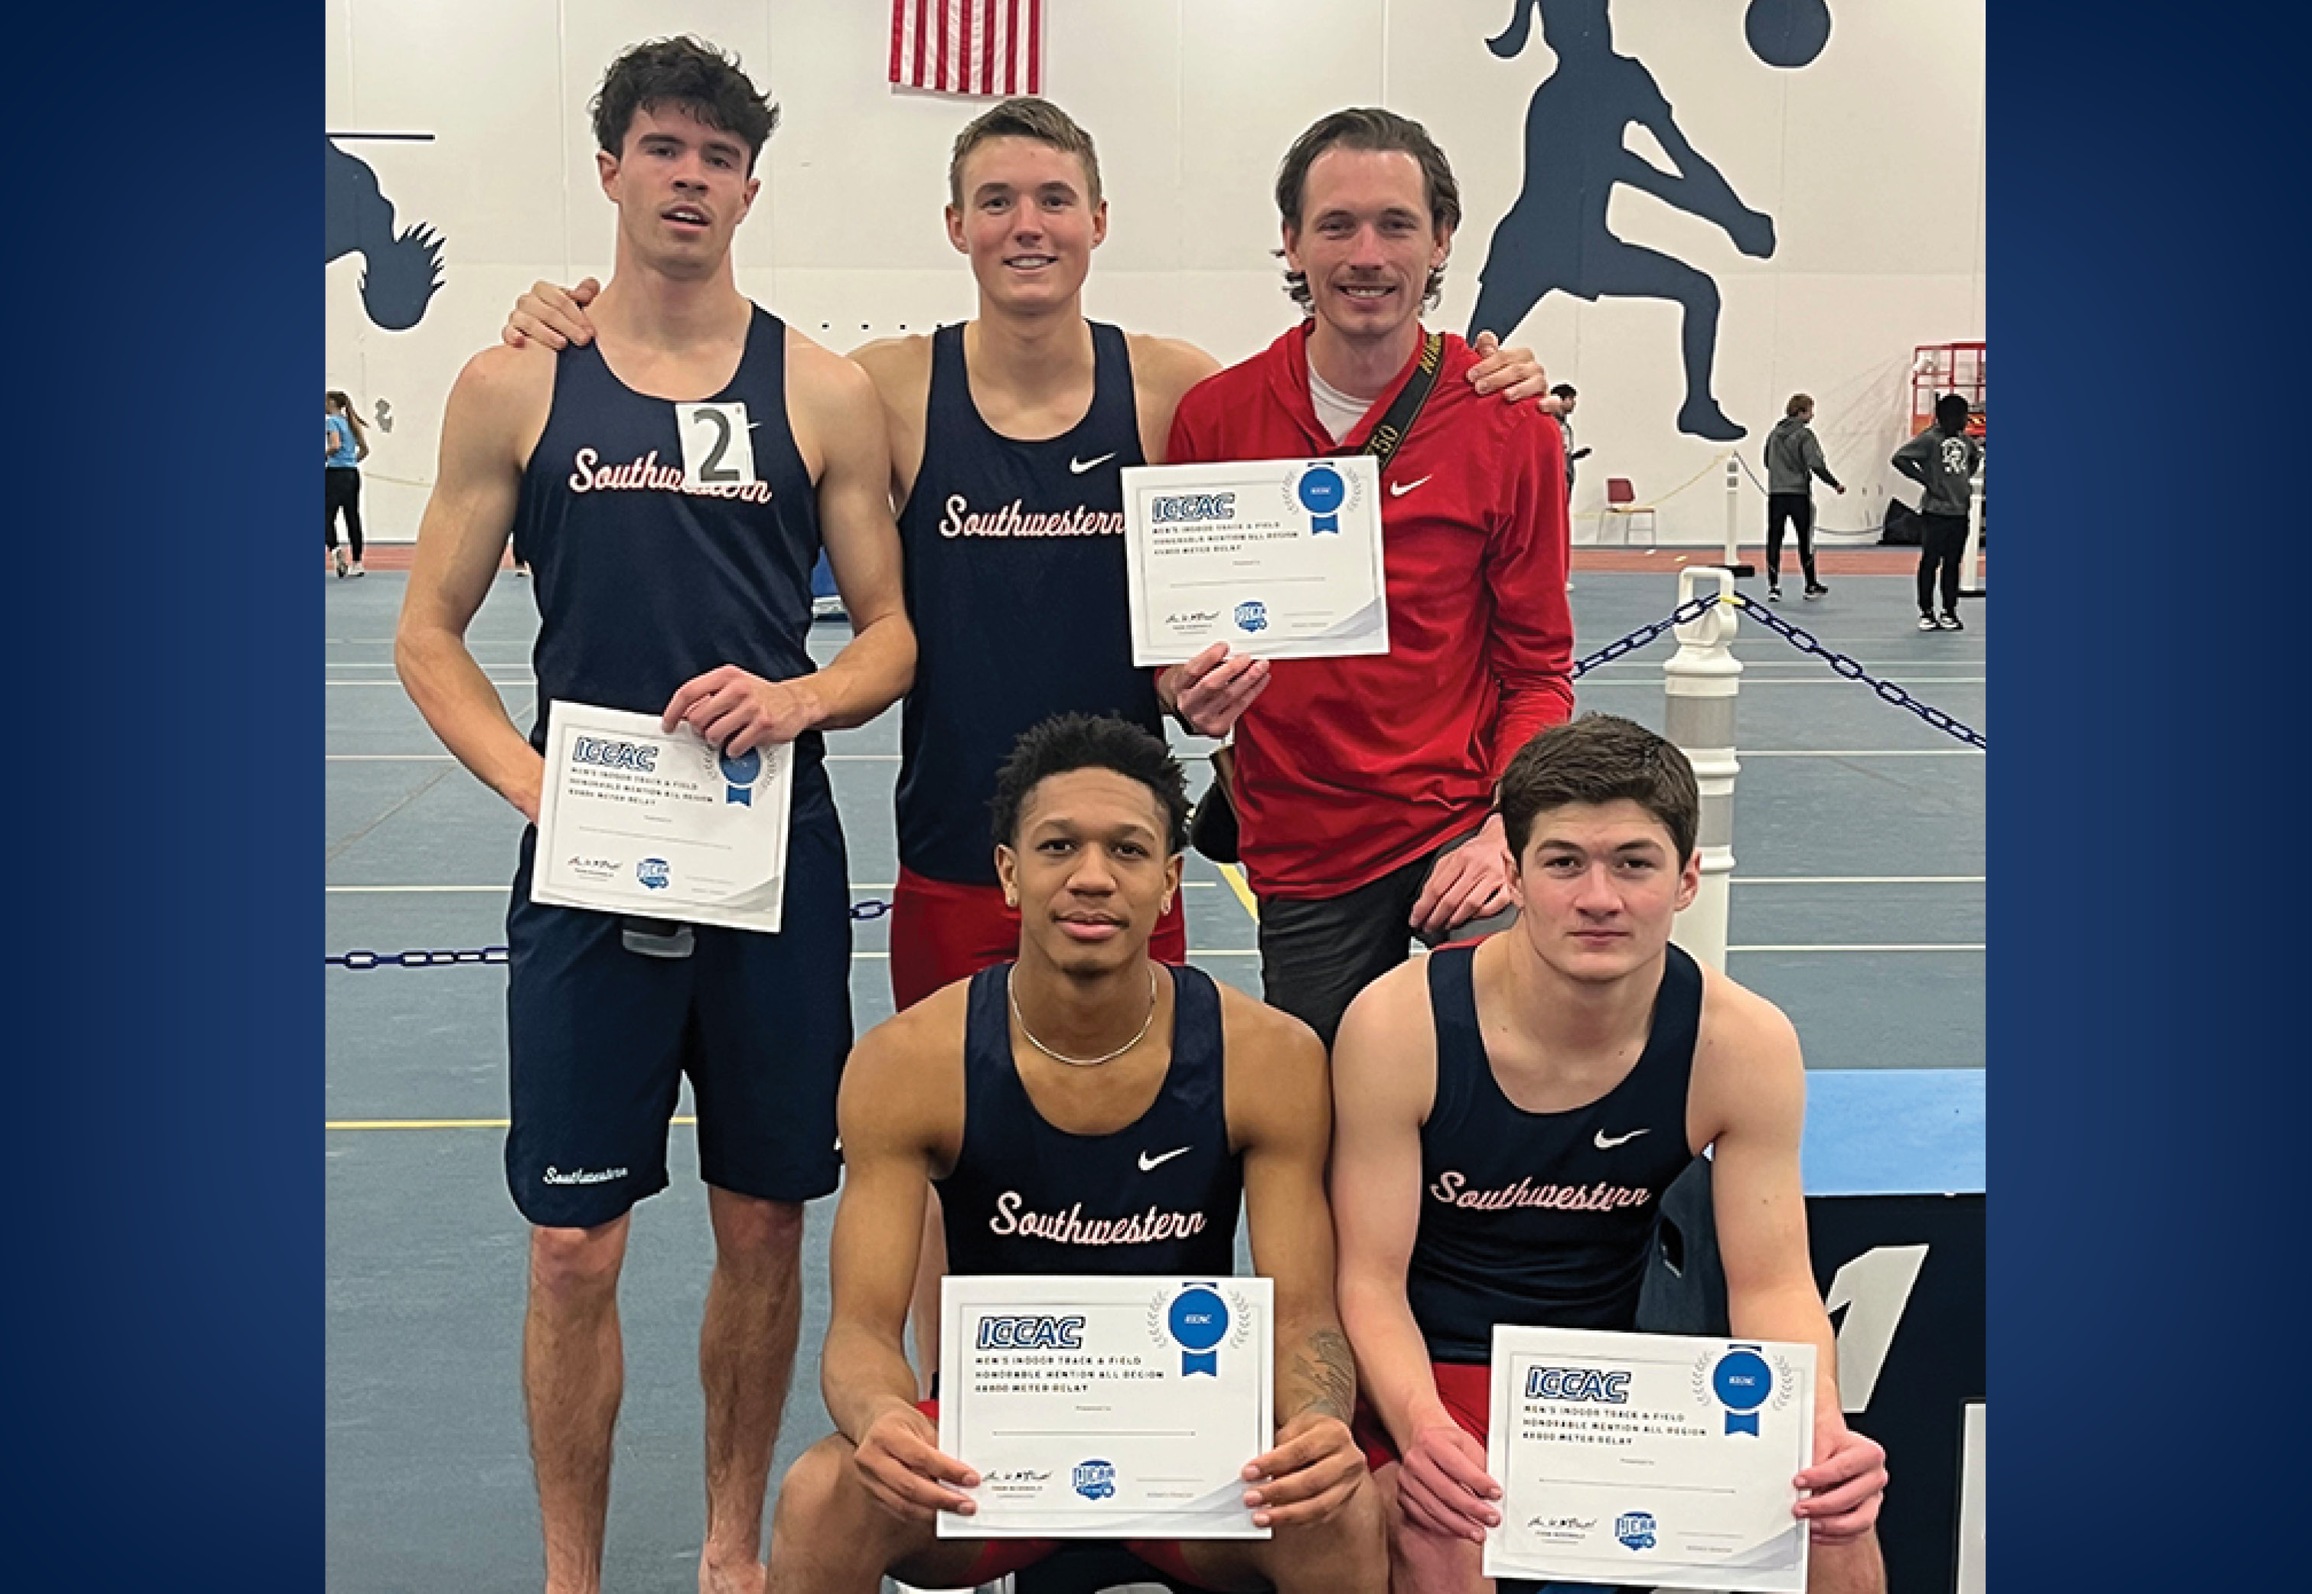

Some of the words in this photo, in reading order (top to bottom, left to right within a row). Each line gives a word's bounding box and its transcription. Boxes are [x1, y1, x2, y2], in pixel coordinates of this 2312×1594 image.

[693, 408, 741, 482] 2
[938, 494, 1126, 538] Southwestern
[1152, 492, 1236, 522] ICCAC
[572, 736, 659, 772] ICCAC
[1430, 1170, 1651, 1212] Southwestern
[989, 1190, 1207, 1245] Southwestern
[975, 1315, 1086, 1349] ICCAC
[1827, 1244, 1929, 1413] 1
[1525, 1365, 1632, 1404] ICCAC
